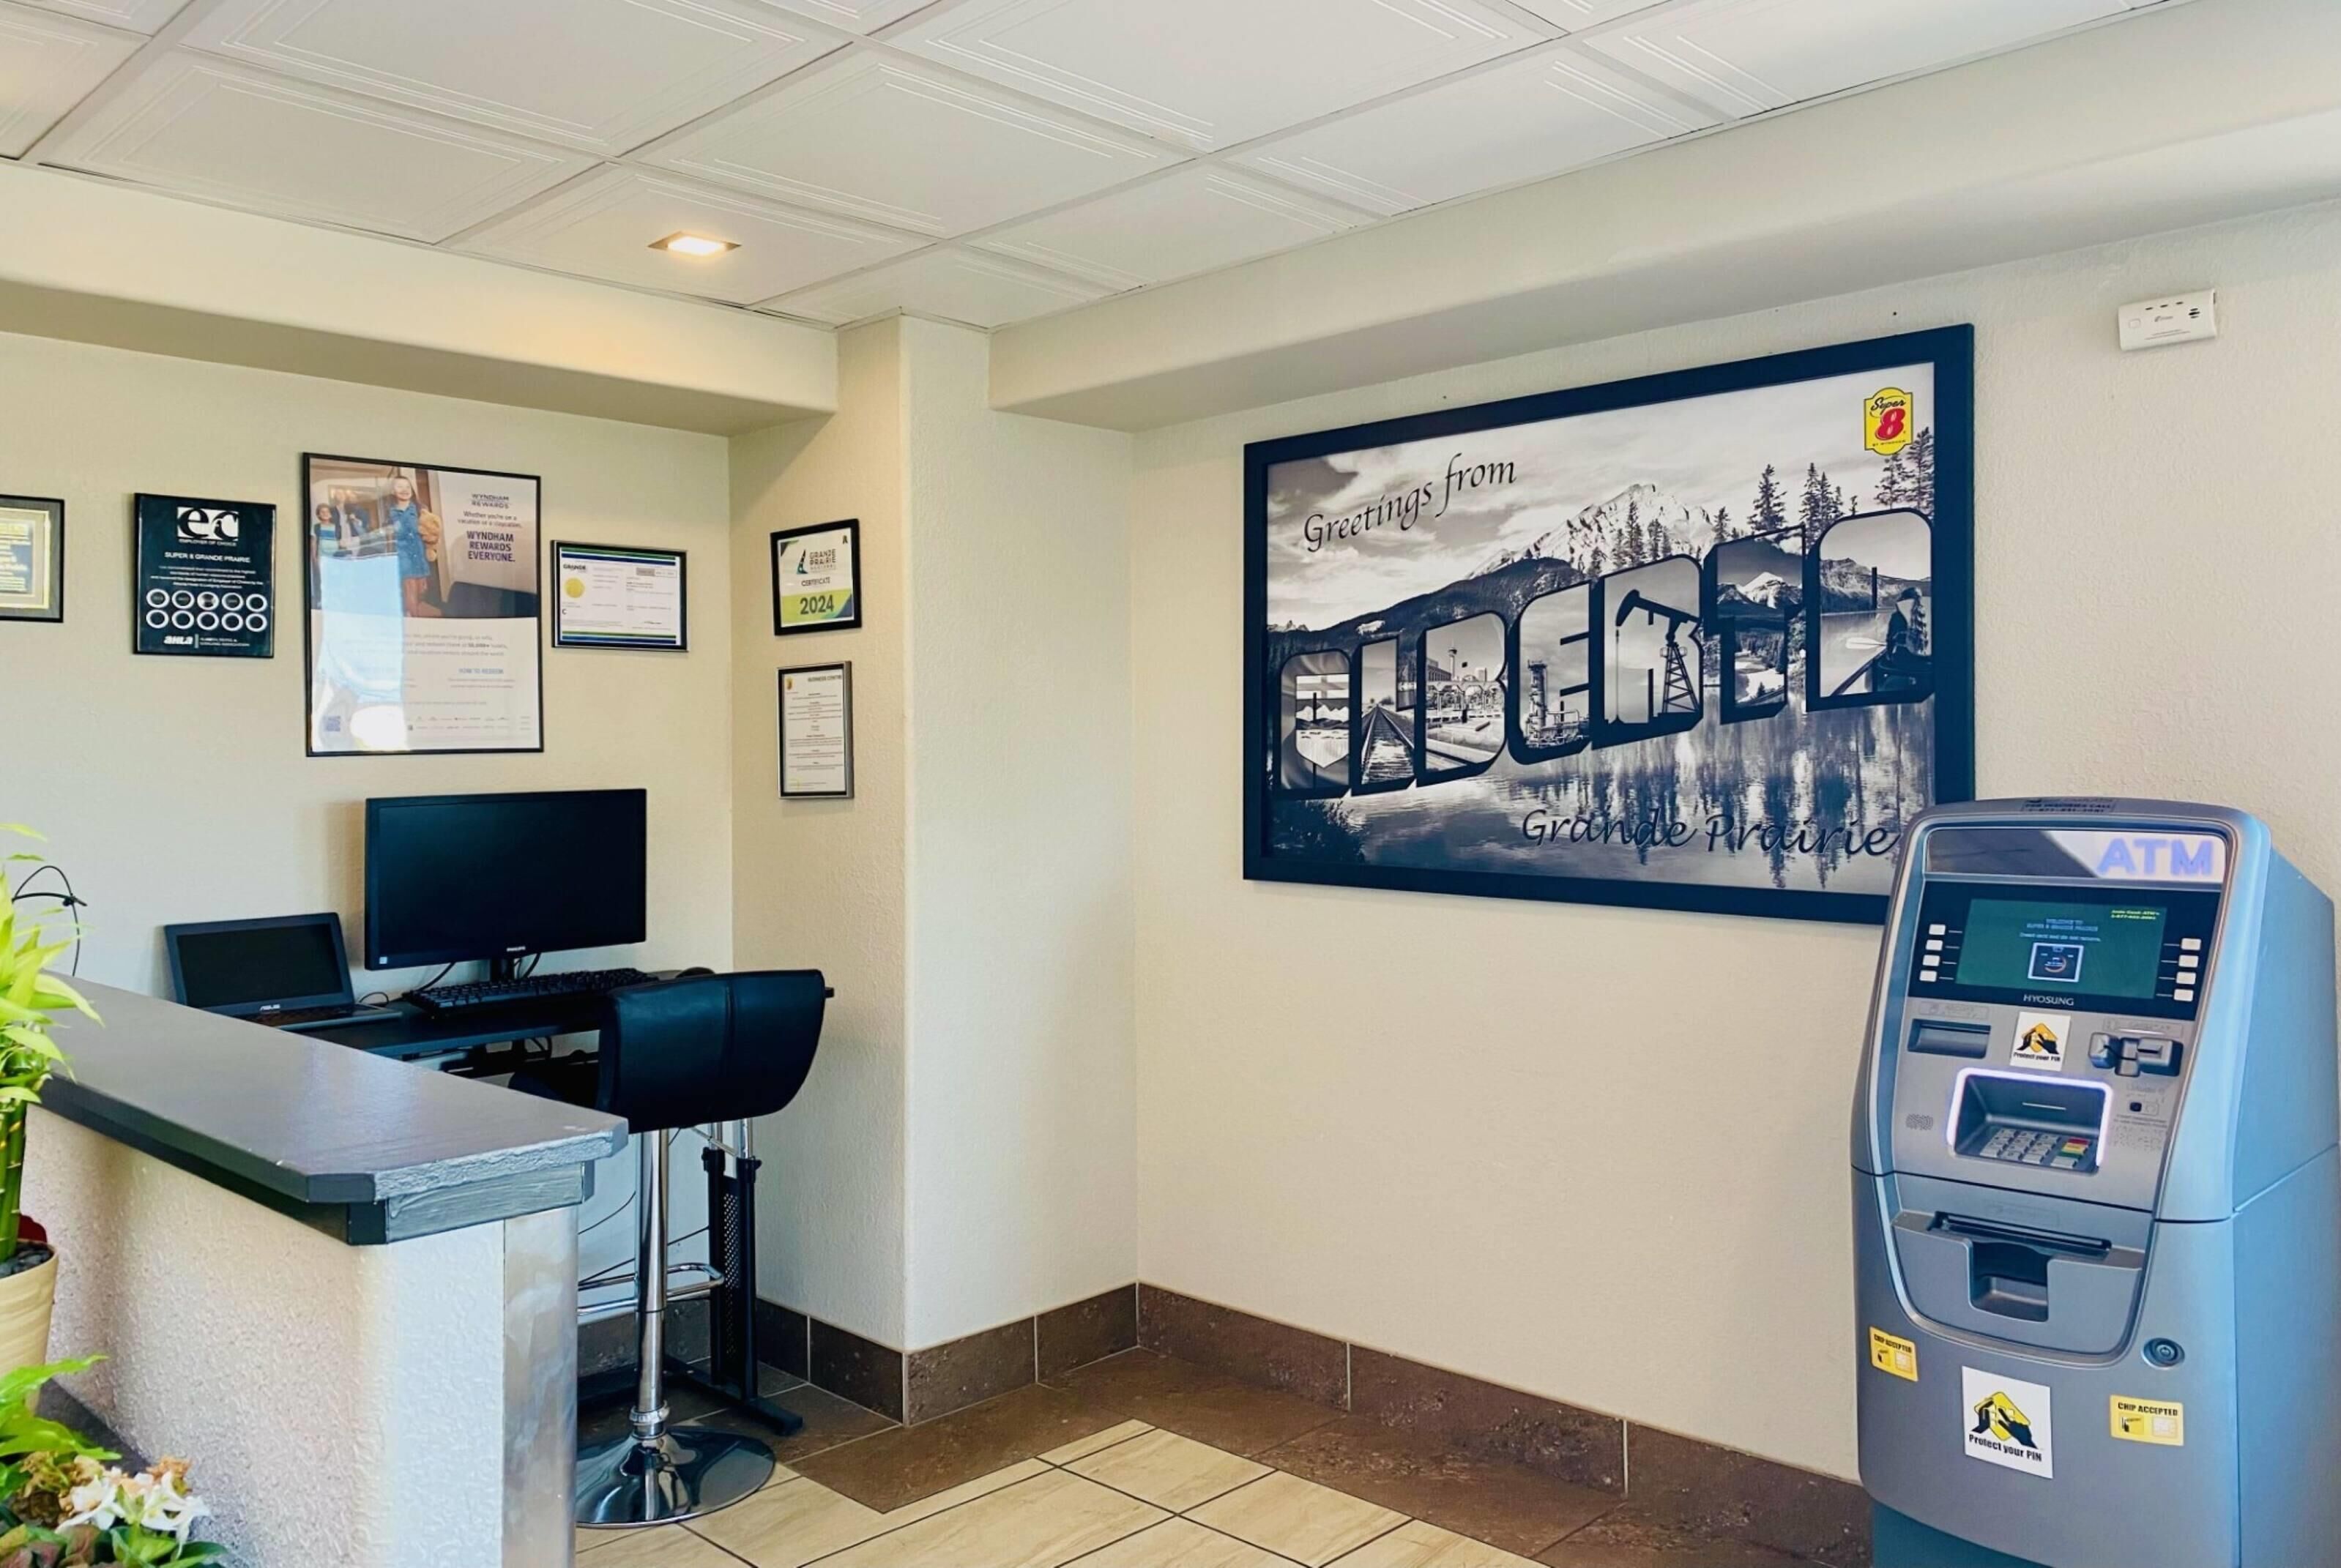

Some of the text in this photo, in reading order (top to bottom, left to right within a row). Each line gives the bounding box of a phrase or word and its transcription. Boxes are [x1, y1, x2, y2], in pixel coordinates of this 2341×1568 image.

[1870, 396, 1906, 414] Super
[1875, 408, 1906, 441] 8
[1303, 452, 1516, 552] Greetings from
[466, 531, 514, 542] WYNDHAM
[469, 541, 512, 552] REWARDS
[809, 548, 836, 559] GRANDE
[468, 550, 516, 562] EVERYONE.
[809, 556, 836, 565] PRAIRIE
[801, 577, 830, 586] CERTIFICATE
[800, 594, 834, 615] 2024
[1522, 807, 1902, 856] Grande Prairie
[2096, 837, 2214, 876] ATM
[2023, 994, 2074, 1006] HYOSUNG
[2118, 1402, 2178, 1416] CHIP ACCEPTED
[1968, 1434, 2042, 1462] Protect your PIN
